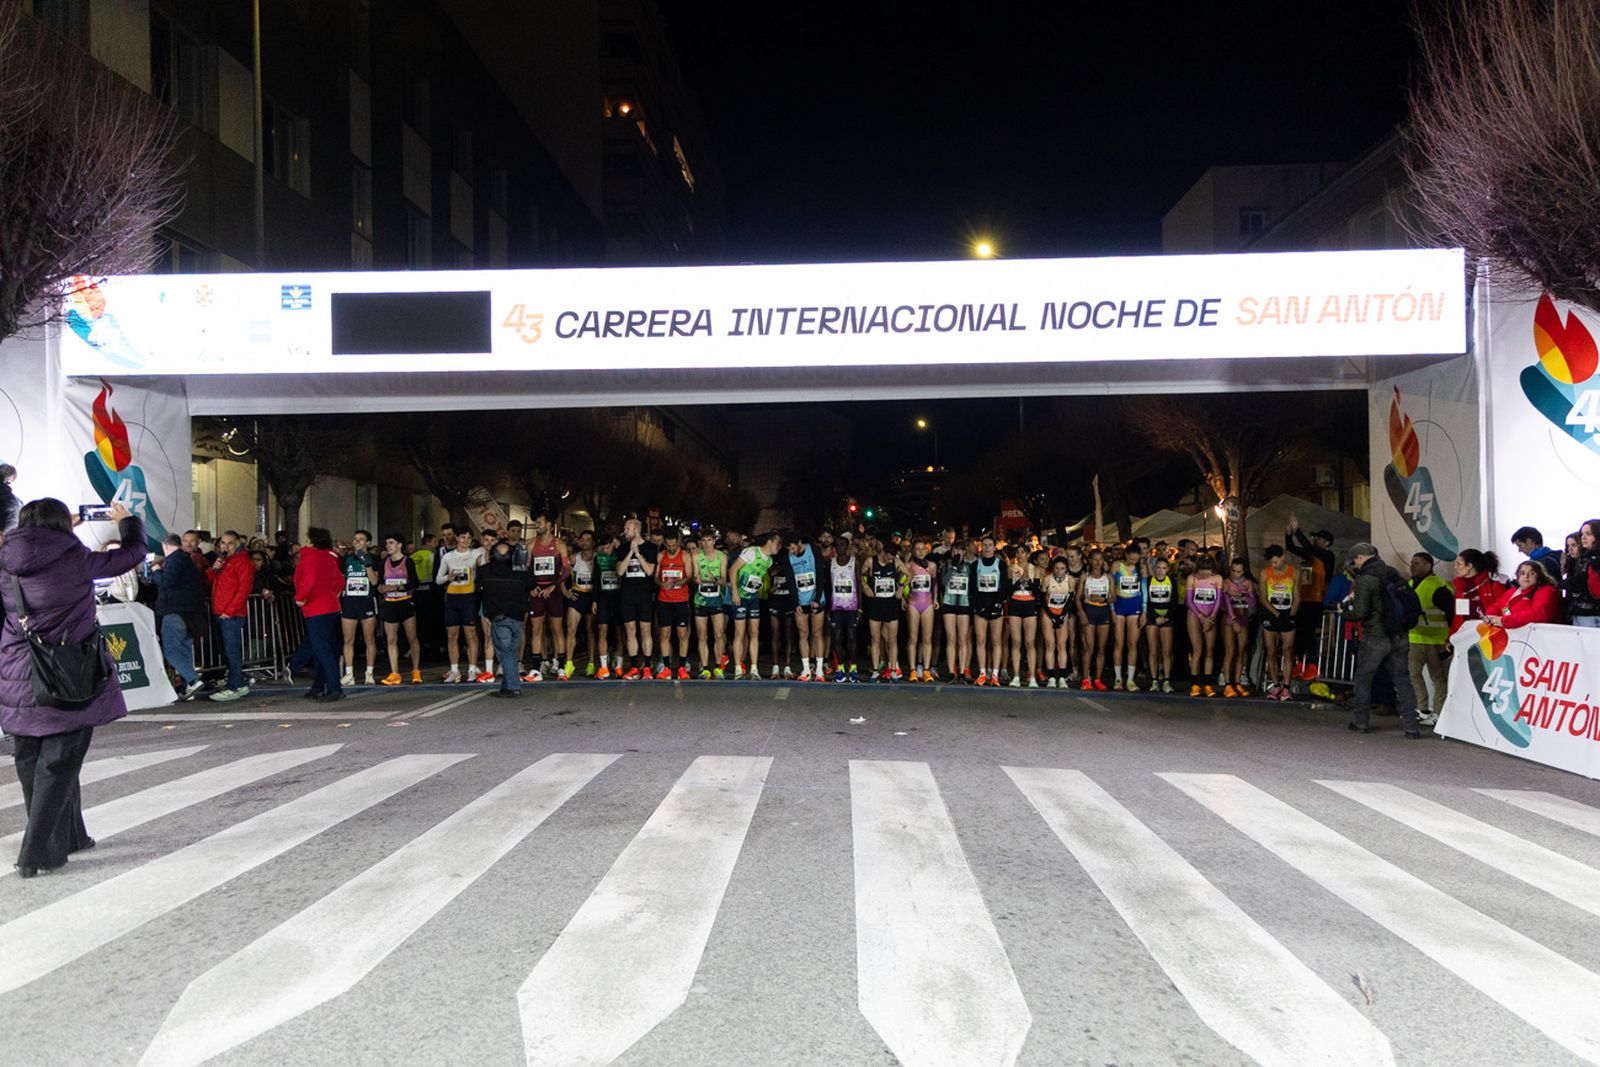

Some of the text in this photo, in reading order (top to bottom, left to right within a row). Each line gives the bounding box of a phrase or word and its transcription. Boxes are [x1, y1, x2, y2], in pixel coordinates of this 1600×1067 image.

[503, 286, 1445, 344] 43 CARRERA INTERNACIONAL NOCHE DE SAN ANTÓN
[1565, 389, 1600, 446] 4
[1002, 510, 1025, 518] PREN
[1404, 482, 1433, 533] 43
[1482, 667, 1514, 714] 43
[1520, 657, 1579, 694] SAN
[1514, 693, 1600, 741] ANTÓN
